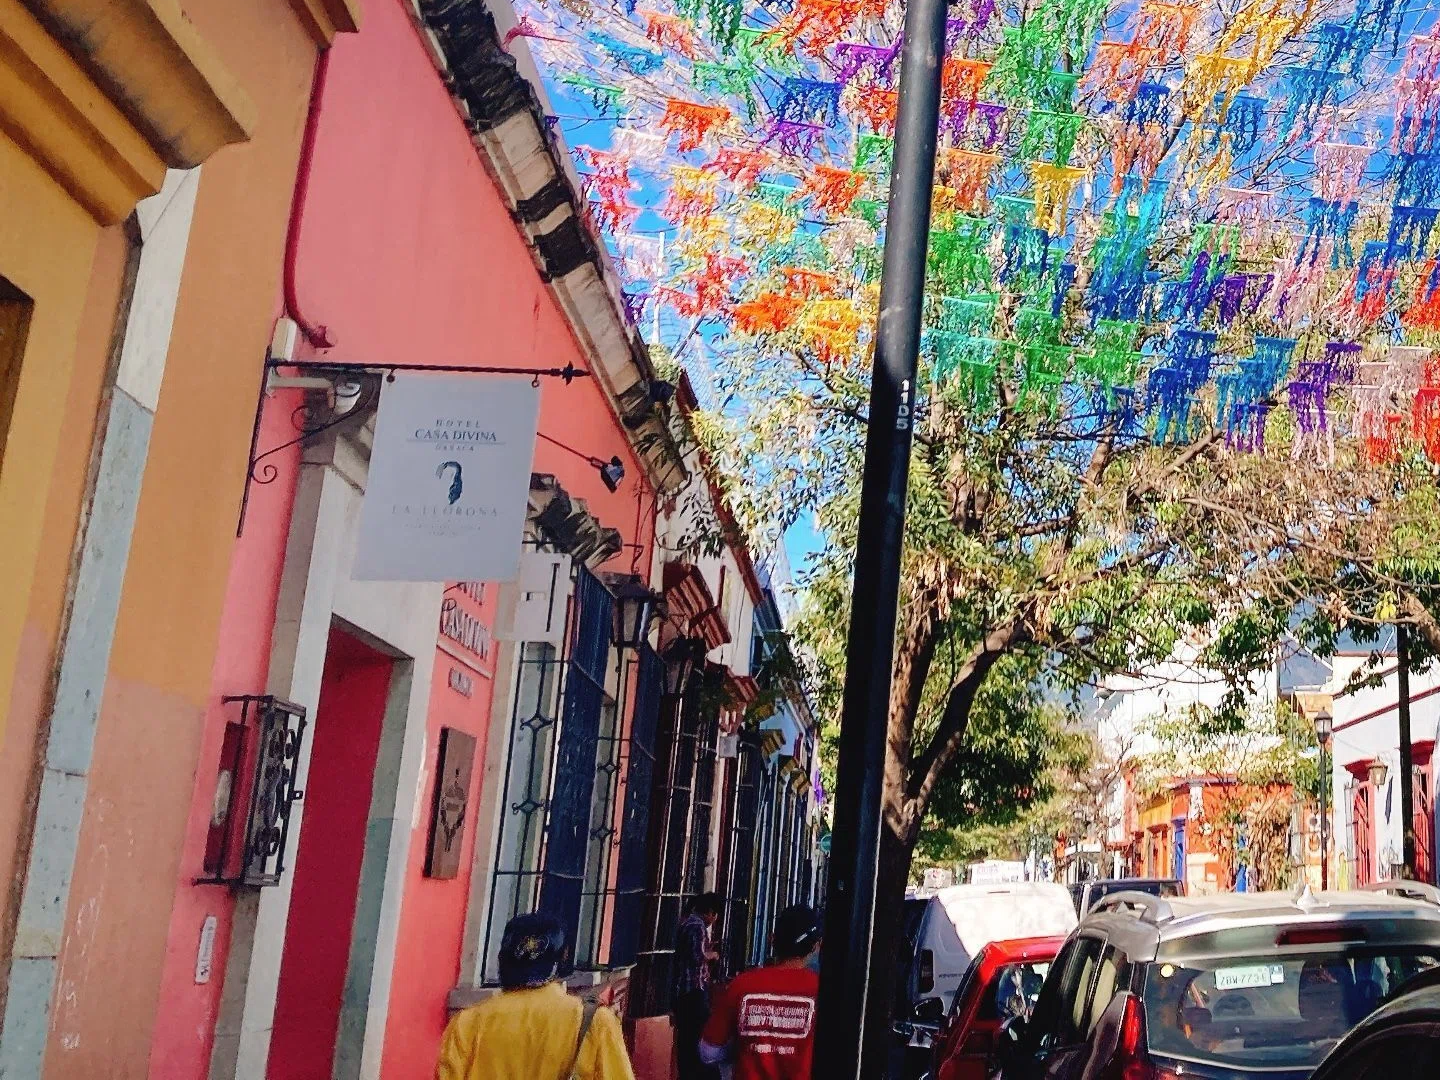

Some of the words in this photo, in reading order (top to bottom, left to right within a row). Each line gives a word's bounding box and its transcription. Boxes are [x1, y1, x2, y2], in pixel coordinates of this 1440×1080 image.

[435, 419, 480, 428] HOTEL
[415, 428, 449, 440] CASA
[452, 429, 497, 441] DIVINA
